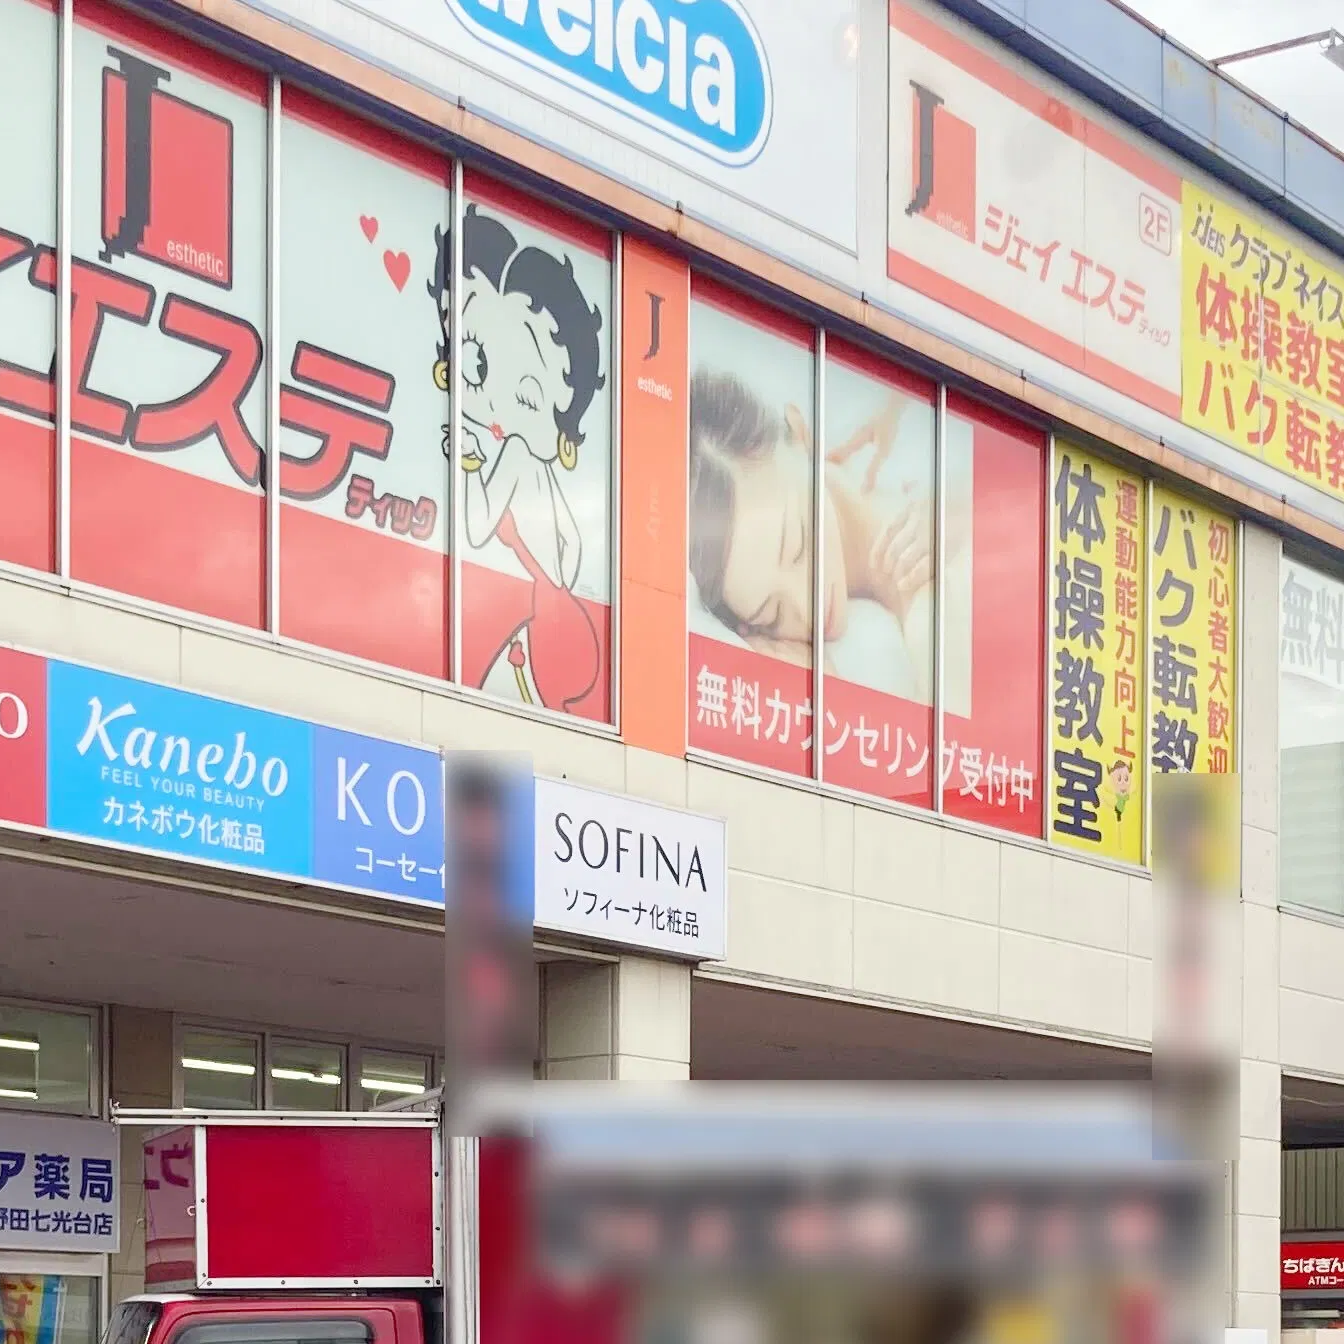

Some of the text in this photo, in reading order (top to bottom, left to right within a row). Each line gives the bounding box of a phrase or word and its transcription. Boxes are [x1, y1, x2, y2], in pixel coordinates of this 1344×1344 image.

[478, 0, 737, 137] elcia
[166, 238, 224, 279] esthetic
[1143, 205, 1170, 243] 2F
[1229, 223, 1292, 292] クラブ
[637, 376, 674, 401] esthetic
[344, 477, 438, 540] ティック
[1053, 455, 1107, 844] 体操教室
[1113, 479, 1138, 760] 運動能力向上
[1281, 569, 1344, 685] 無料
[76, 694, 290, 798] Kanebo
[695, 663, 1035, 814] 無料カウンセリング受付中
[101, 765, 266, 813] FEEL YOUR BEAUTY
[102, 794, 266, 855] カネボウ化粧品
[552, 811, 708, 893] SOFINA
[562, 885, 700, 939] ソフィーナ化粧品
